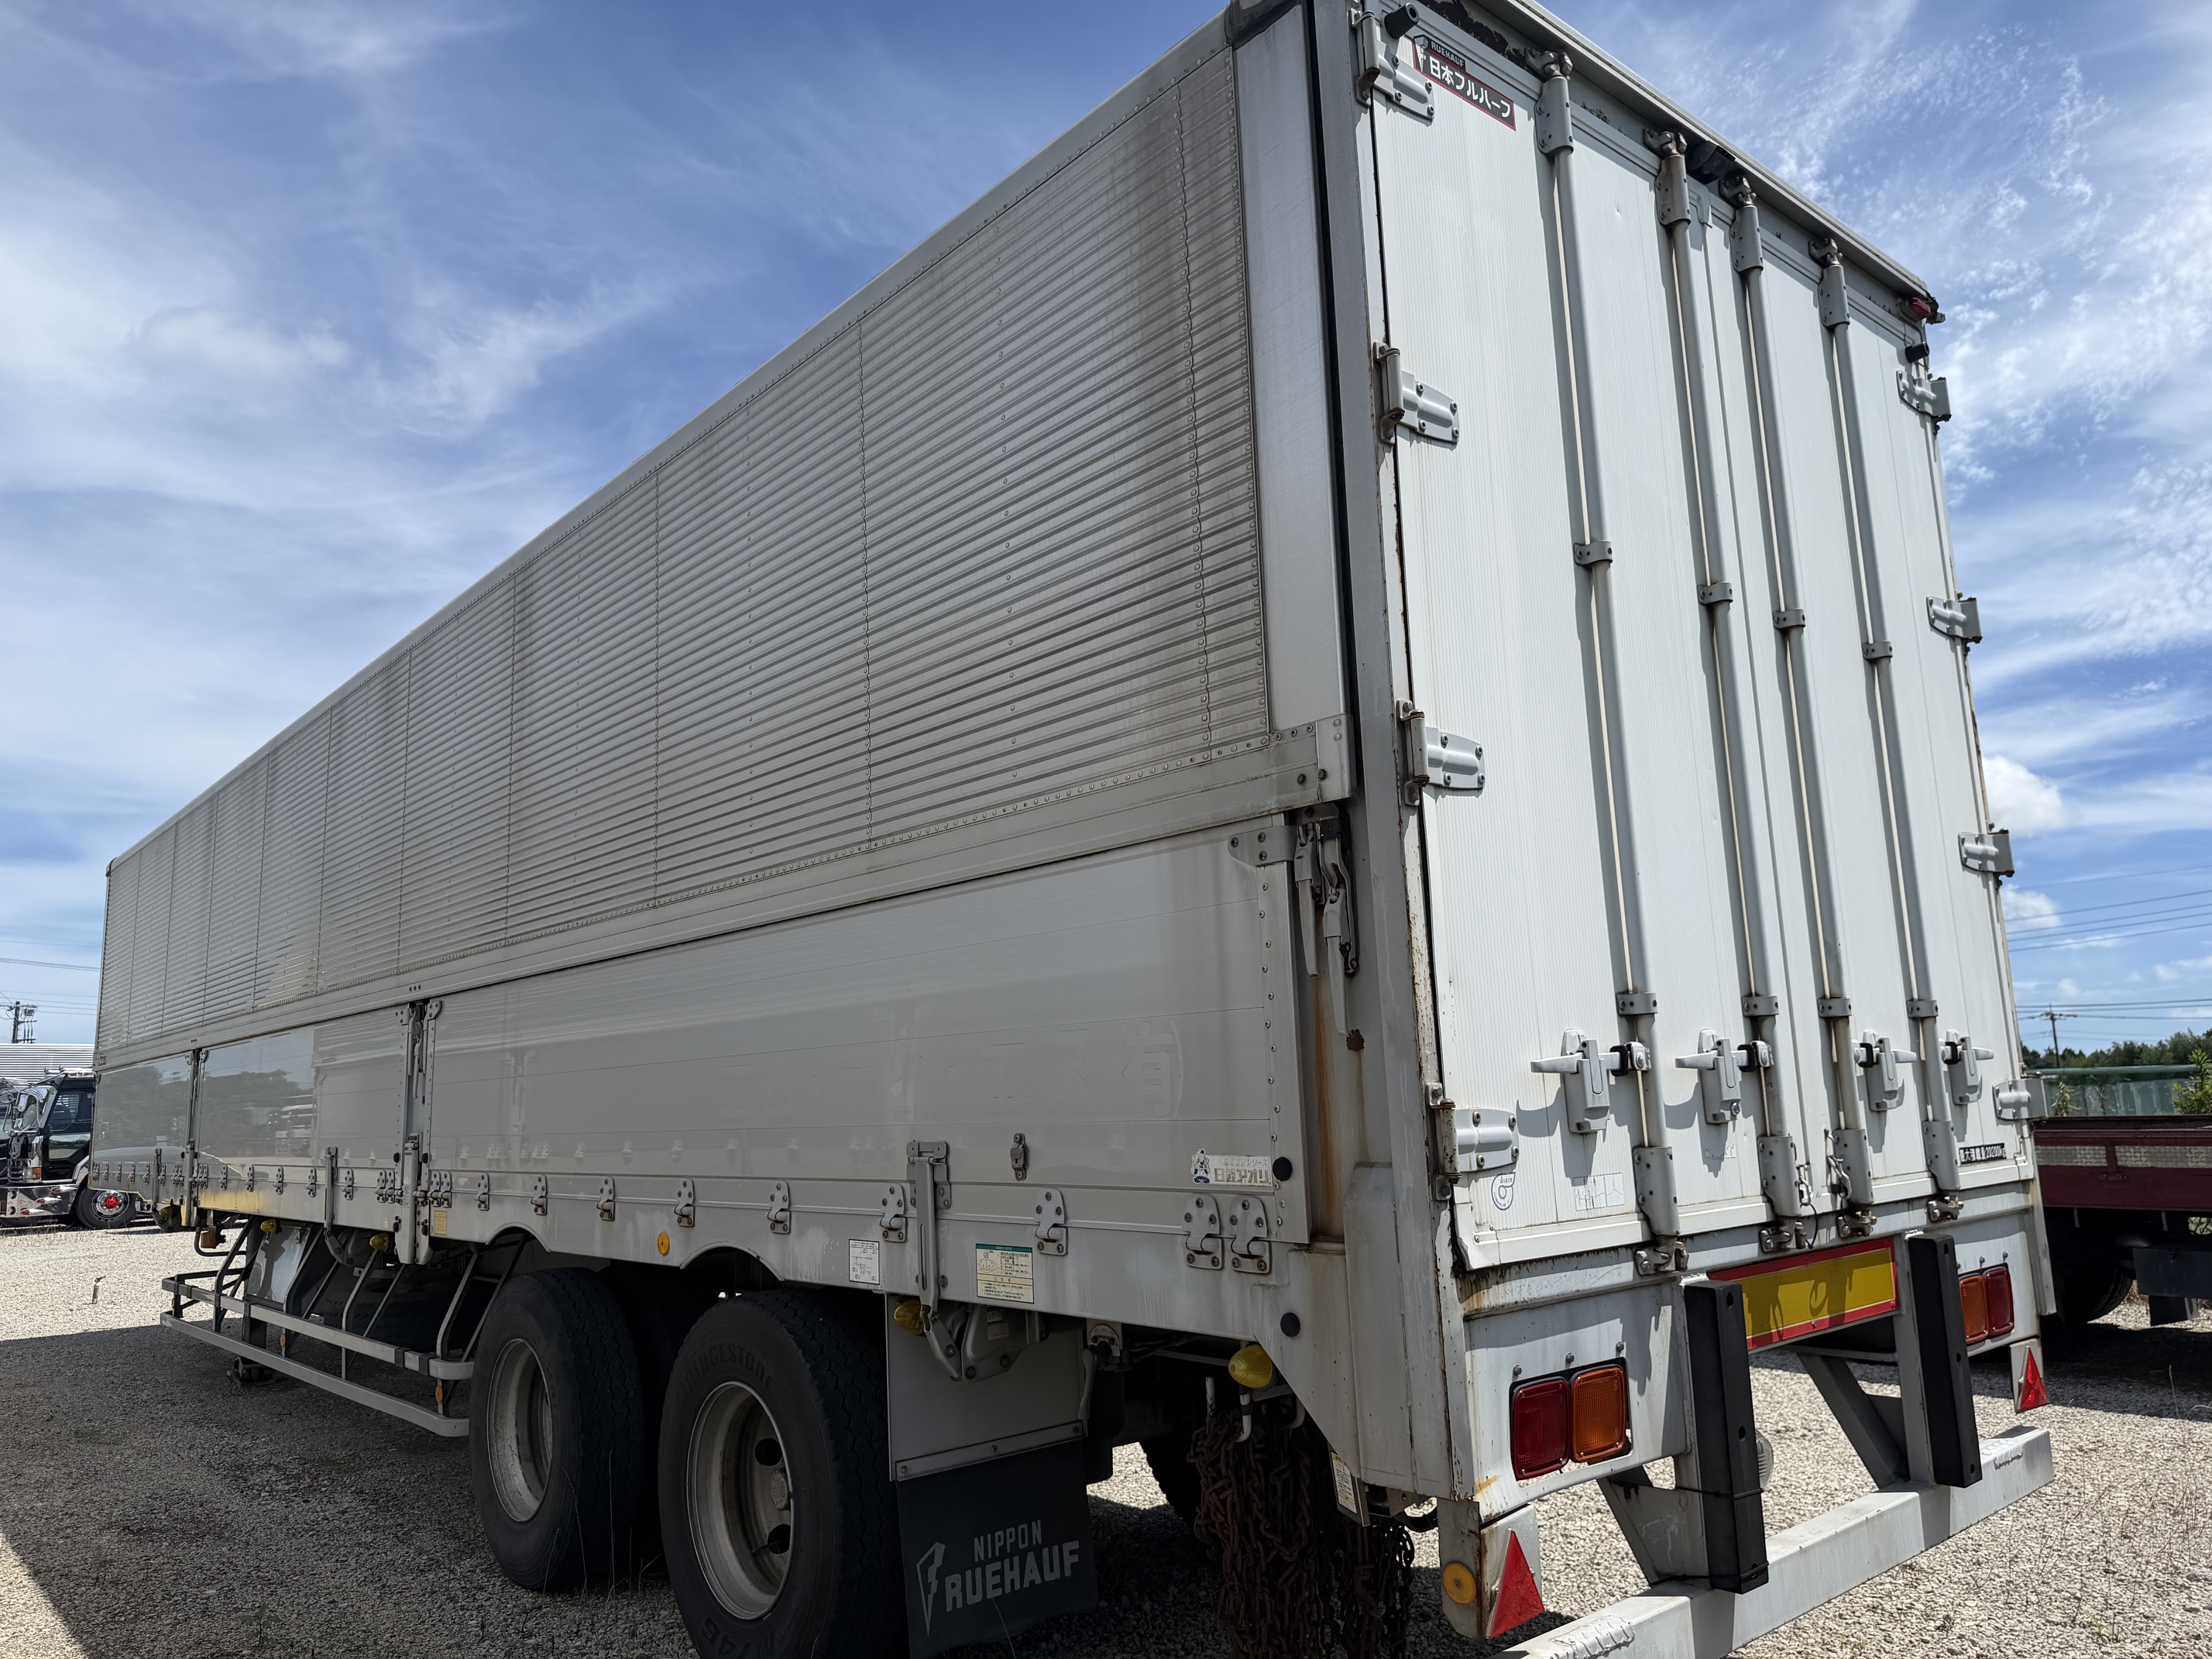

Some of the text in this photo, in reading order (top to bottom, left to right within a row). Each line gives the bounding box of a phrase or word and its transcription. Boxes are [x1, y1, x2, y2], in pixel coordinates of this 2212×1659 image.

[1430, 57, 1511, 118] 日本フルハーフ
[676, 1342, 774, 1406] BRIDGESTONE
[974, 1519, 1042, 1562] NIPPON
